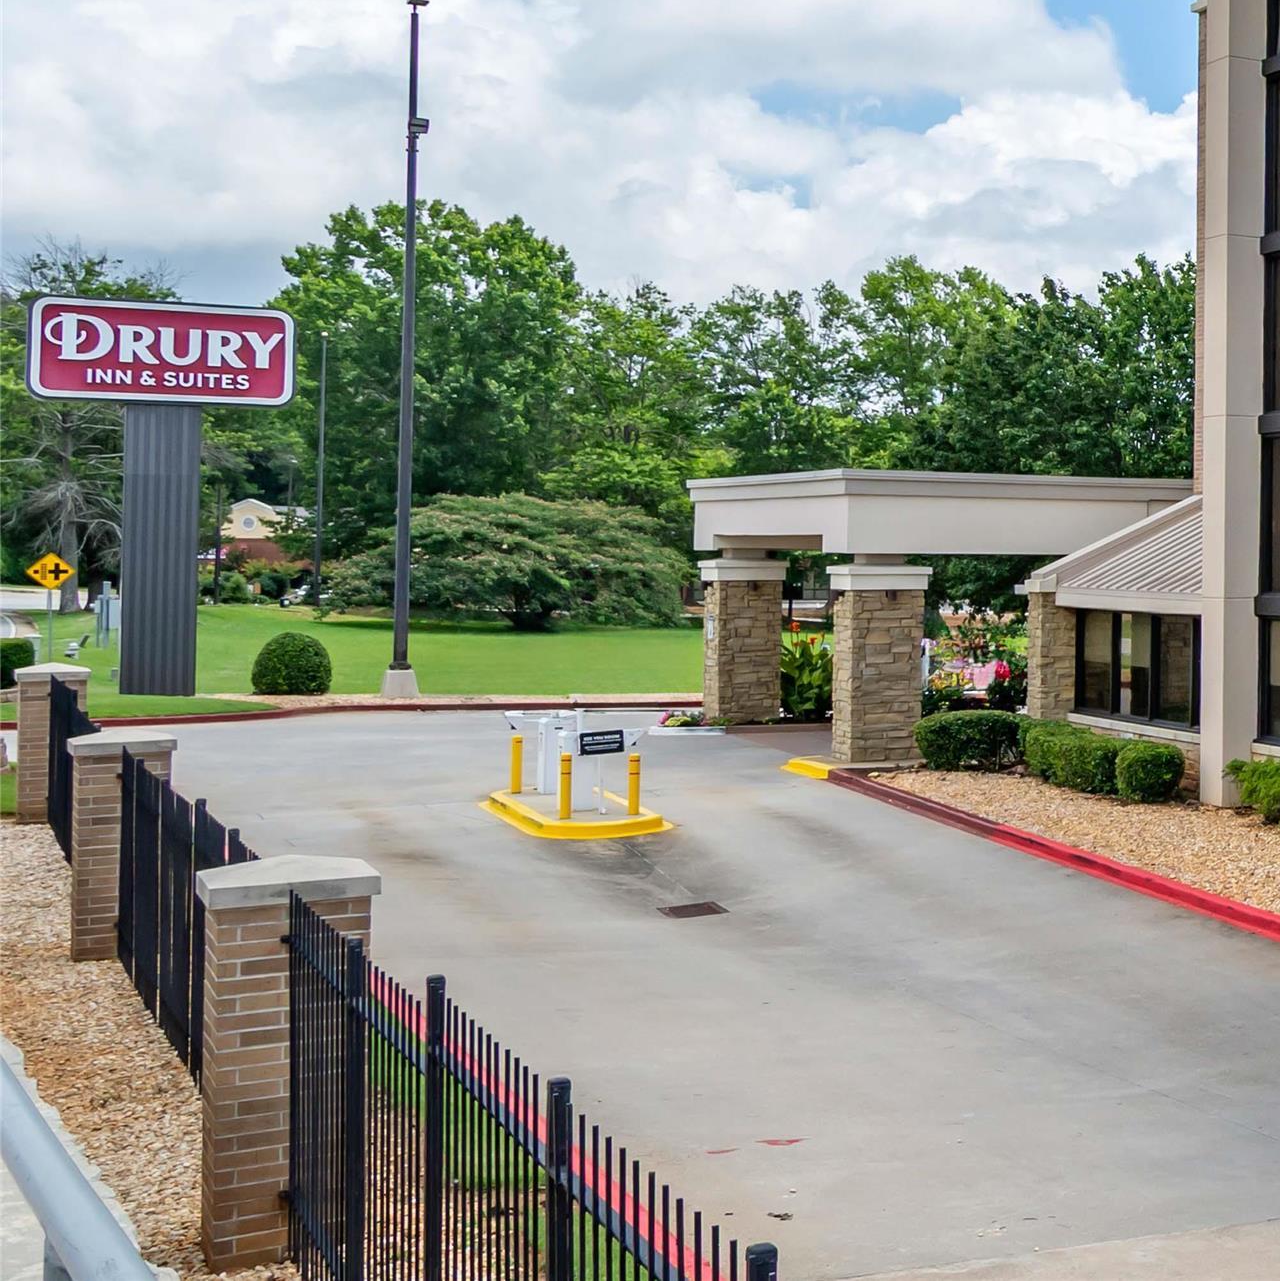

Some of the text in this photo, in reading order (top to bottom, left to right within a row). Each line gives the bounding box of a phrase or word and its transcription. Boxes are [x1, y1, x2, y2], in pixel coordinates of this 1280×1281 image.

[44, 312, 285, 369] DRURY
[86, 368, 250, 390] INN & SUITES
